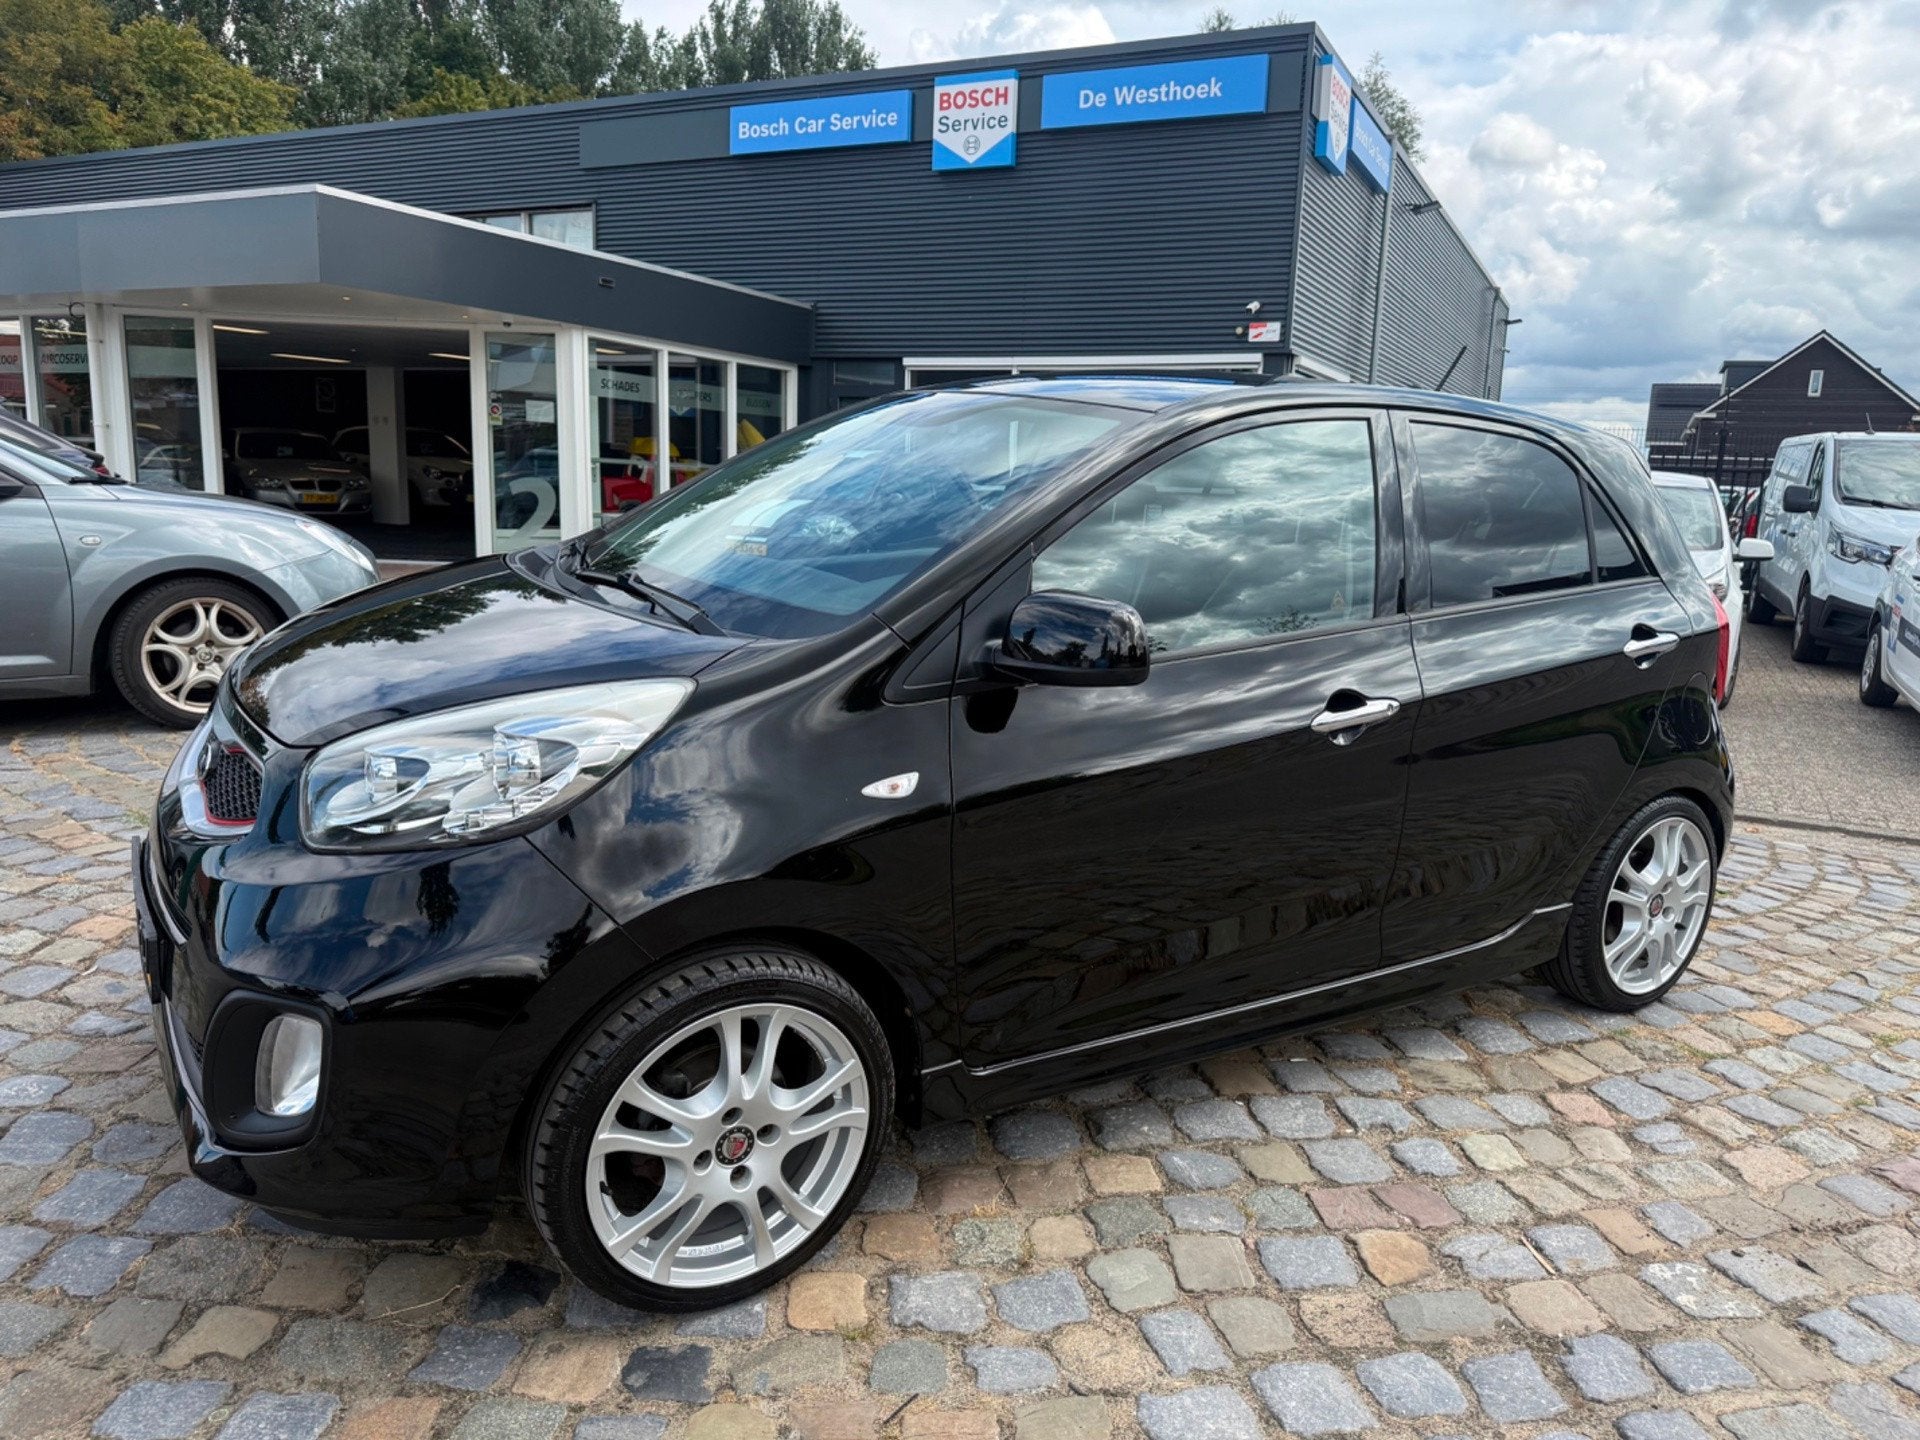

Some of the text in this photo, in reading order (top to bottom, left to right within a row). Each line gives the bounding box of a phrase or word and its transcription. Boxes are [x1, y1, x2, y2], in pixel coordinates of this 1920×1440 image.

[939, 86, 1008, 112] BOSCH
[1079, 76, 1222, 109] De Westhoek
[738, 109, 898, 140] Bosch Car Service
[938, 112, 1008, 133] Service
[0, 354, 18, 366] OOP
[601, 378, 641, 393] SCHADES
